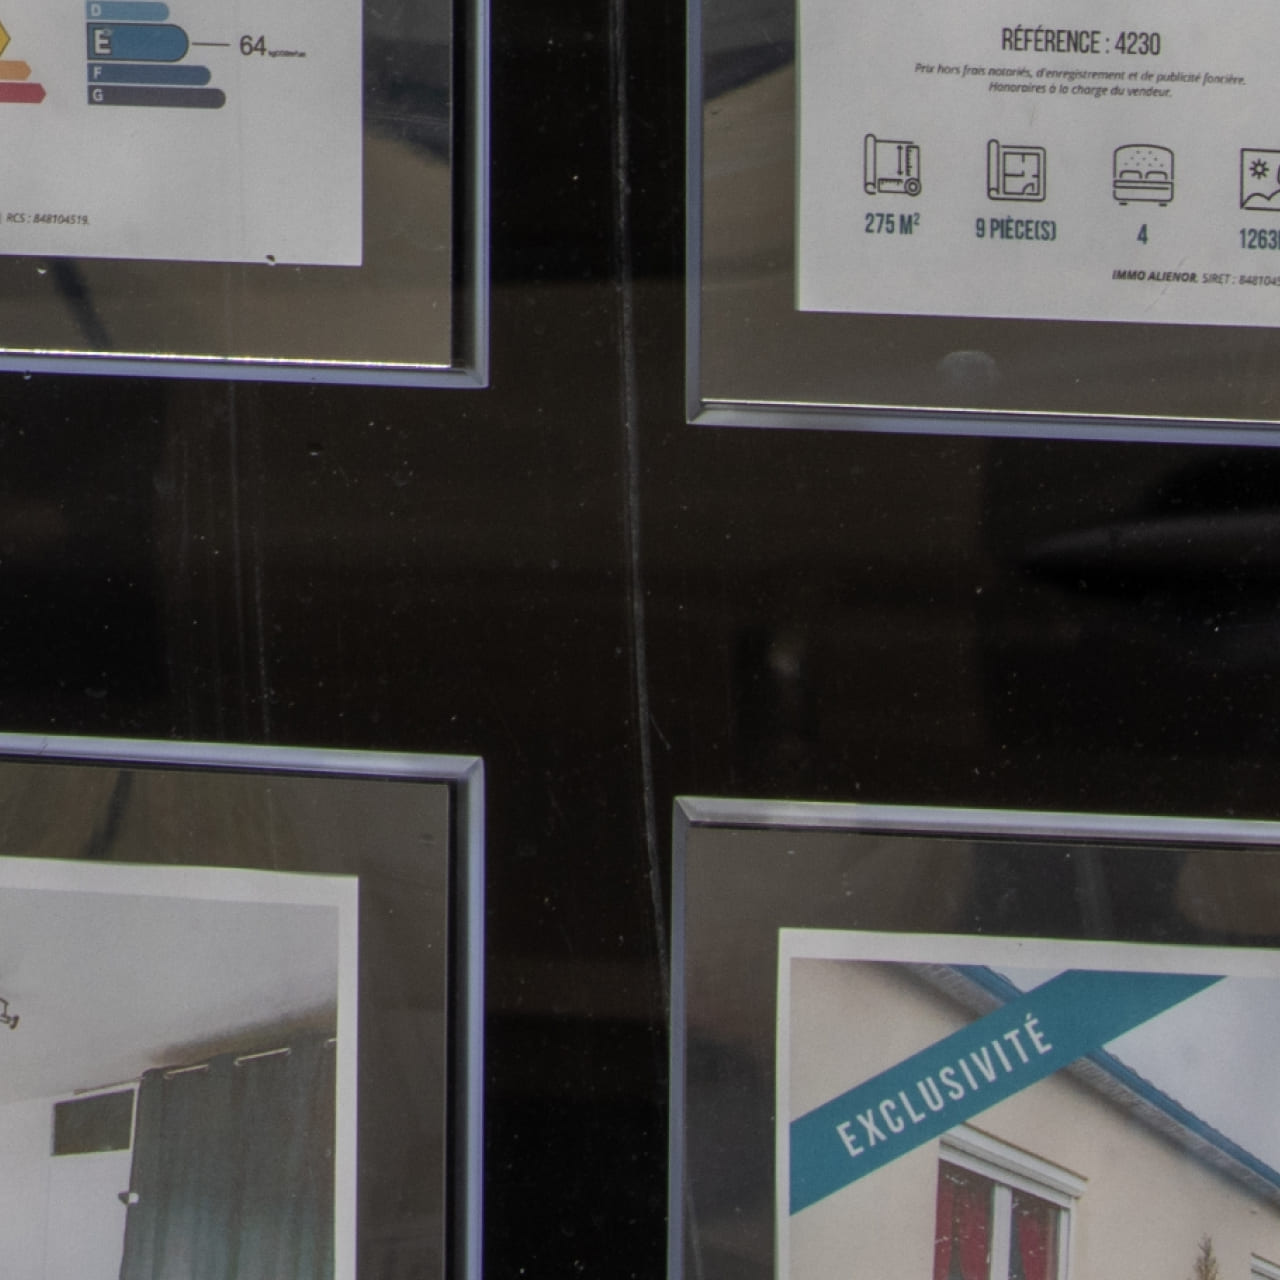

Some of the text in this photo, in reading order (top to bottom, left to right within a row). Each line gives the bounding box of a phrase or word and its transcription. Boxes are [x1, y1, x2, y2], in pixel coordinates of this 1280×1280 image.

[239, 34, 268, 58] 64
[1001, 23, 1102, 55] RÉFÉRENCE
[1114, 30, 1161, 56] 4230
[835, 1012, 1054, 1159] EXCLUSIVITÉ
